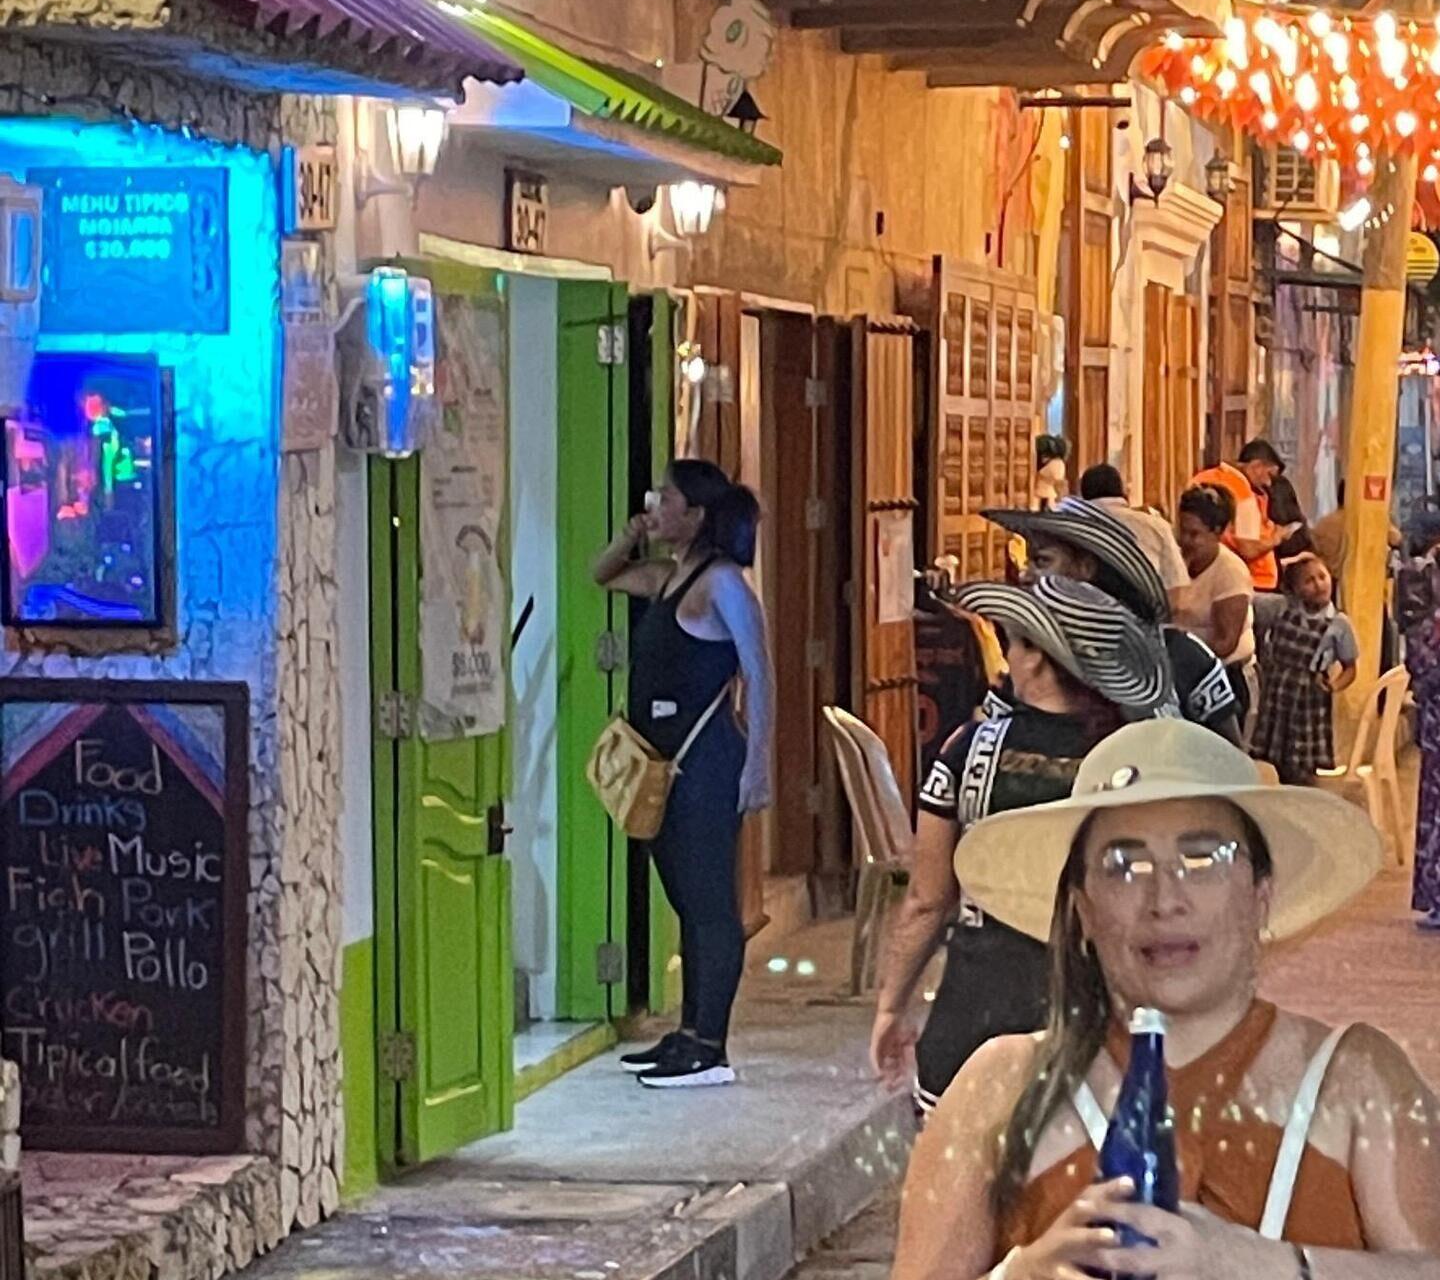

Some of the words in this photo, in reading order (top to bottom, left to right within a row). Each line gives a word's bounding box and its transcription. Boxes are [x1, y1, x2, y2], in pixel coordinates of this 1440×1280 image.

[61, 193, 119, 214] MENU
[75, 739, 163, 795] Food
[19, 789, 147, 833] Drinks
[40, 830, 104, 869] Live
[107, 832, 221, 884] Music
[13, 918, 105, 983] grill
[122, 930, 208, 990] Pollo
